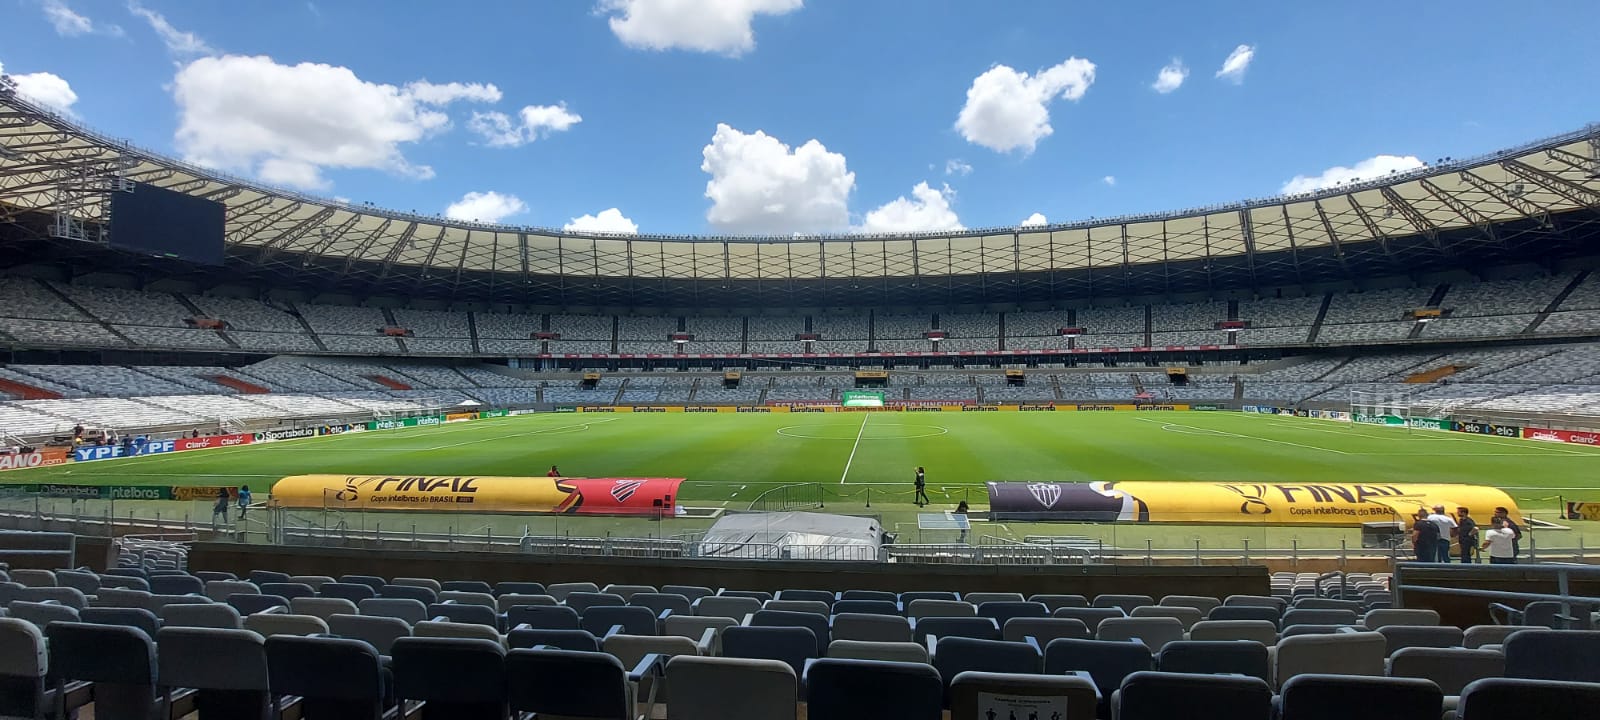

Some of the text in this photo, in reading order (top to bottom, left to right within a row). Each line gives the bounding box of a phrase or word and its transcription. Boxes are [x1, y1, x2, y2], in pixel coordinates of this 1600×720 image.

[1018, 404, 1056, 412] Eurofarma
[1136, 404, 1175, 412] Eurofarma
[265, 428, 313, 440] Sportsbet.io
[1533, 430, 1558, 441] Claro
[1570, 433, 1598, 444] Claro
[185, 439, 210, 449] Claro
[221, 435, 244, 446] Claro
[78, 447, 124, 460] YPF
[370, 495, 387, 503] Copa
[388, 495, 419, 503] intelbras
[1289, 507, 1312, 516] Copa
[1313, 506, 1356, 516] intelbras
[1358, 508, 1369, 516] do
